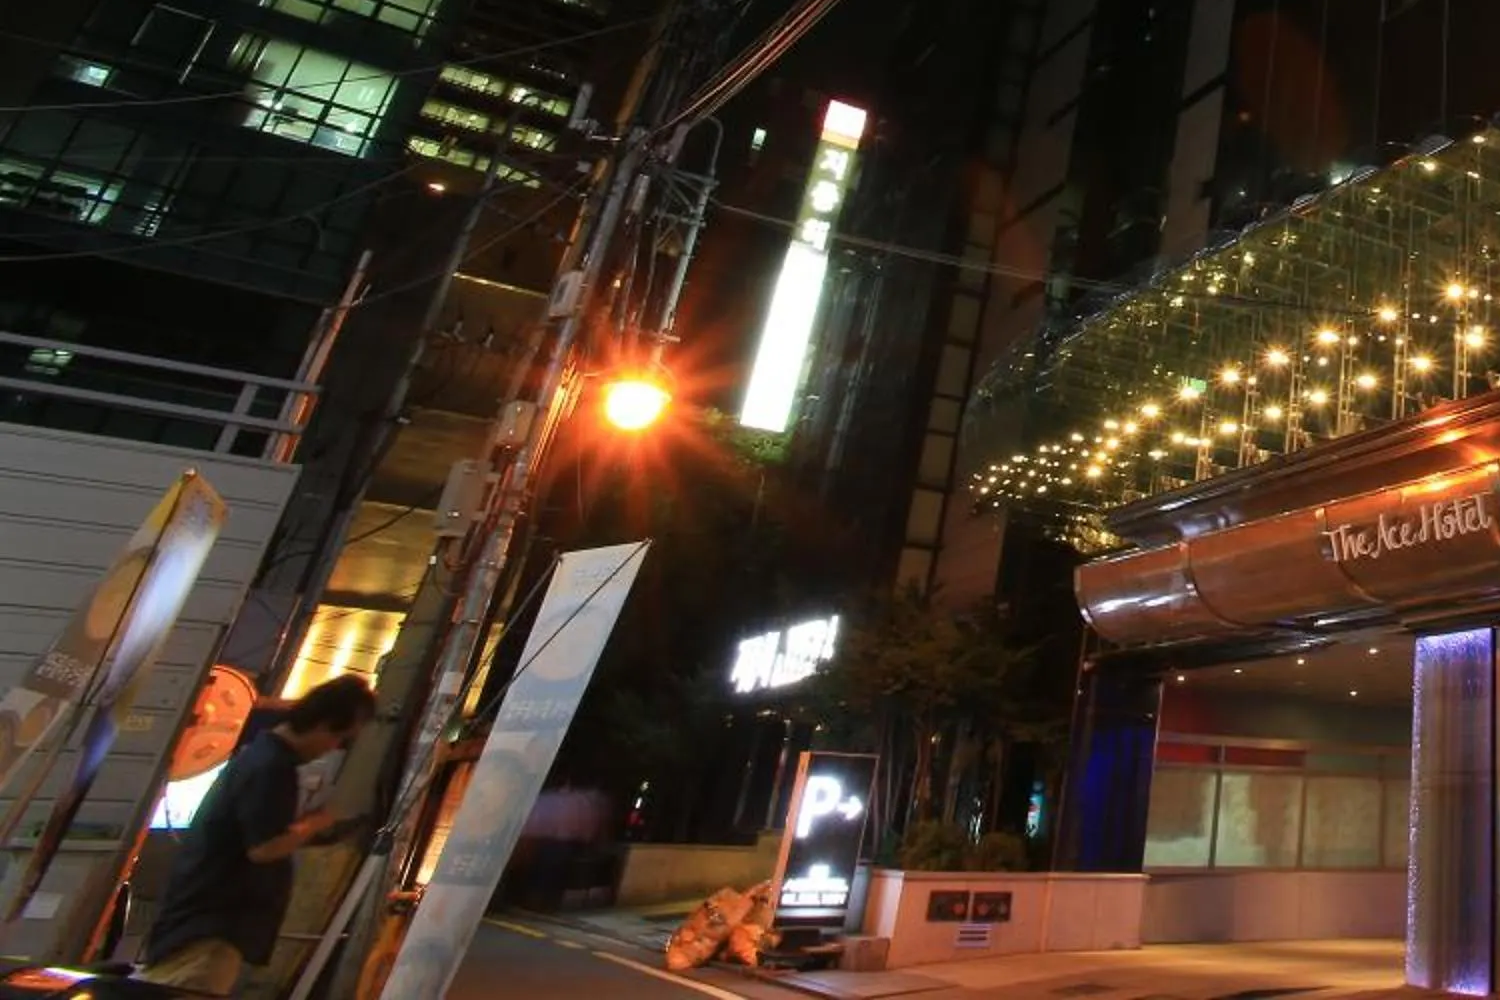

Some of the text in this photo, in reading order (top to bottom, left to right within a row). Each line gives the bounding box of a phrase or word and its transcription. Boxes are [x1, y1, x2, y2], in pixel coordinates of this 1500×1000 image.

[1322, 494, 1493, 562] The Ace Hotel
[797, 776, 841, 838] P
